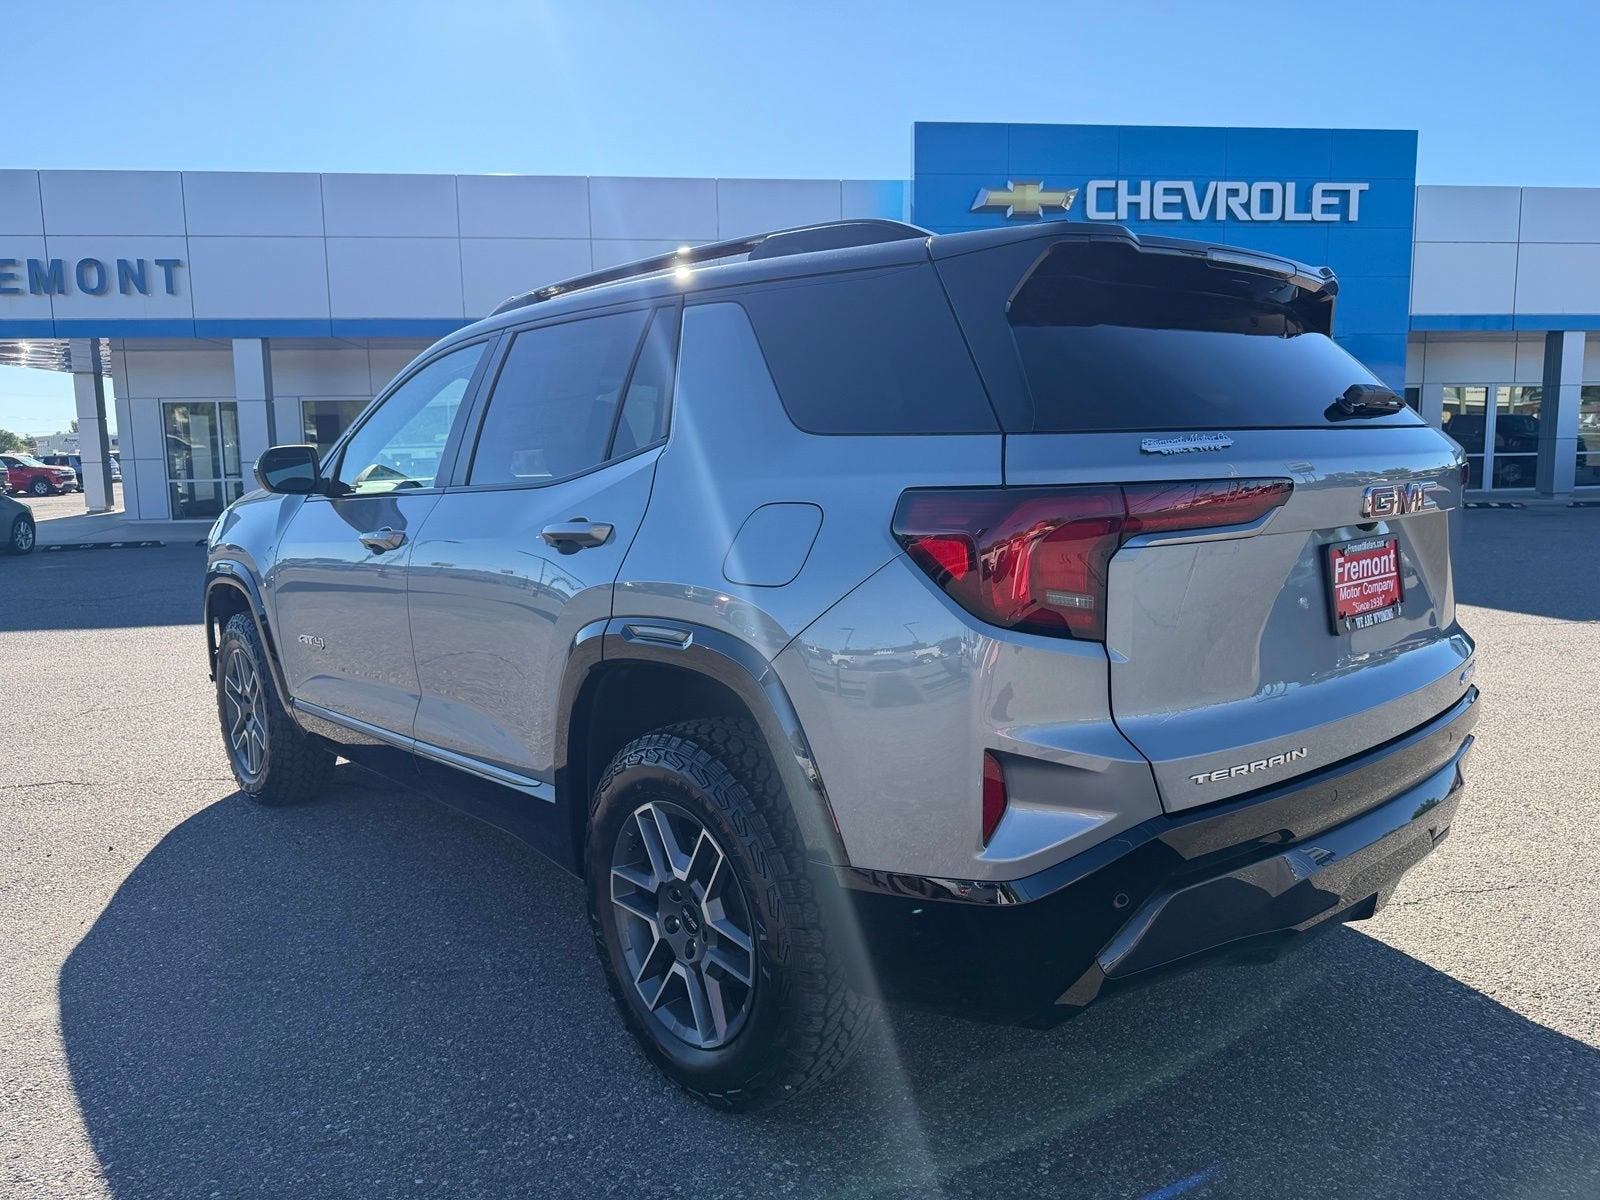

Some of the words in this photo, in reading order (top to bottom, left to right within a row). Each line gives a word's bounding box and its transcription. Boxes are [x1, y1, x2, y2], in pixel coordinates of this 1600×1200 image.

[1085, 179, 1370, 222] CHEVROLET
[1363, 480, 1438, 518] GMC
[1334, 549, 1396, 584] Fremont
[1339, 586, 1361, 601] Motor
[1362, 579, 1394, 595] Company
[1189, 747, 1308, 785] TERRAIN
